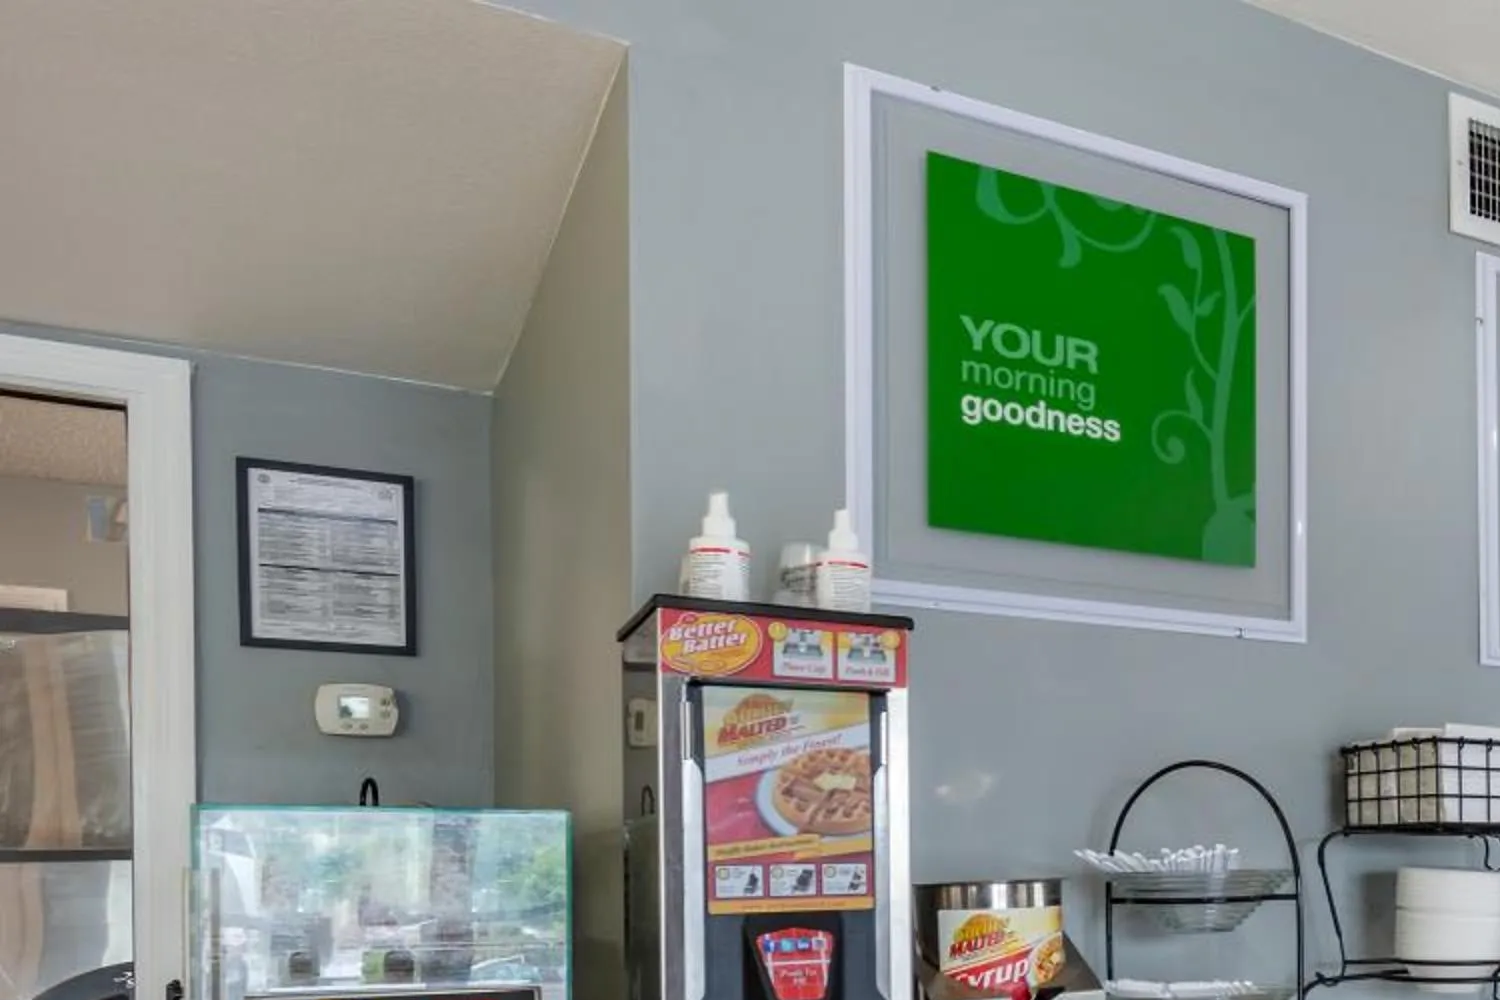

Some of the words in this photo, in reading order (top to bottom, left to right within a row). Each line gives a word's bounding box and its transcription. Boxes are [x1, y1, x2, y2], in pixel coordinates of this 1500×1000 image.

[959, 314, 1099, 374] YOUR
[960, 358, 1096, 412] morning
[960, 393, 1121, 442] goodness
[956, 959, 1028, 989] yrup
